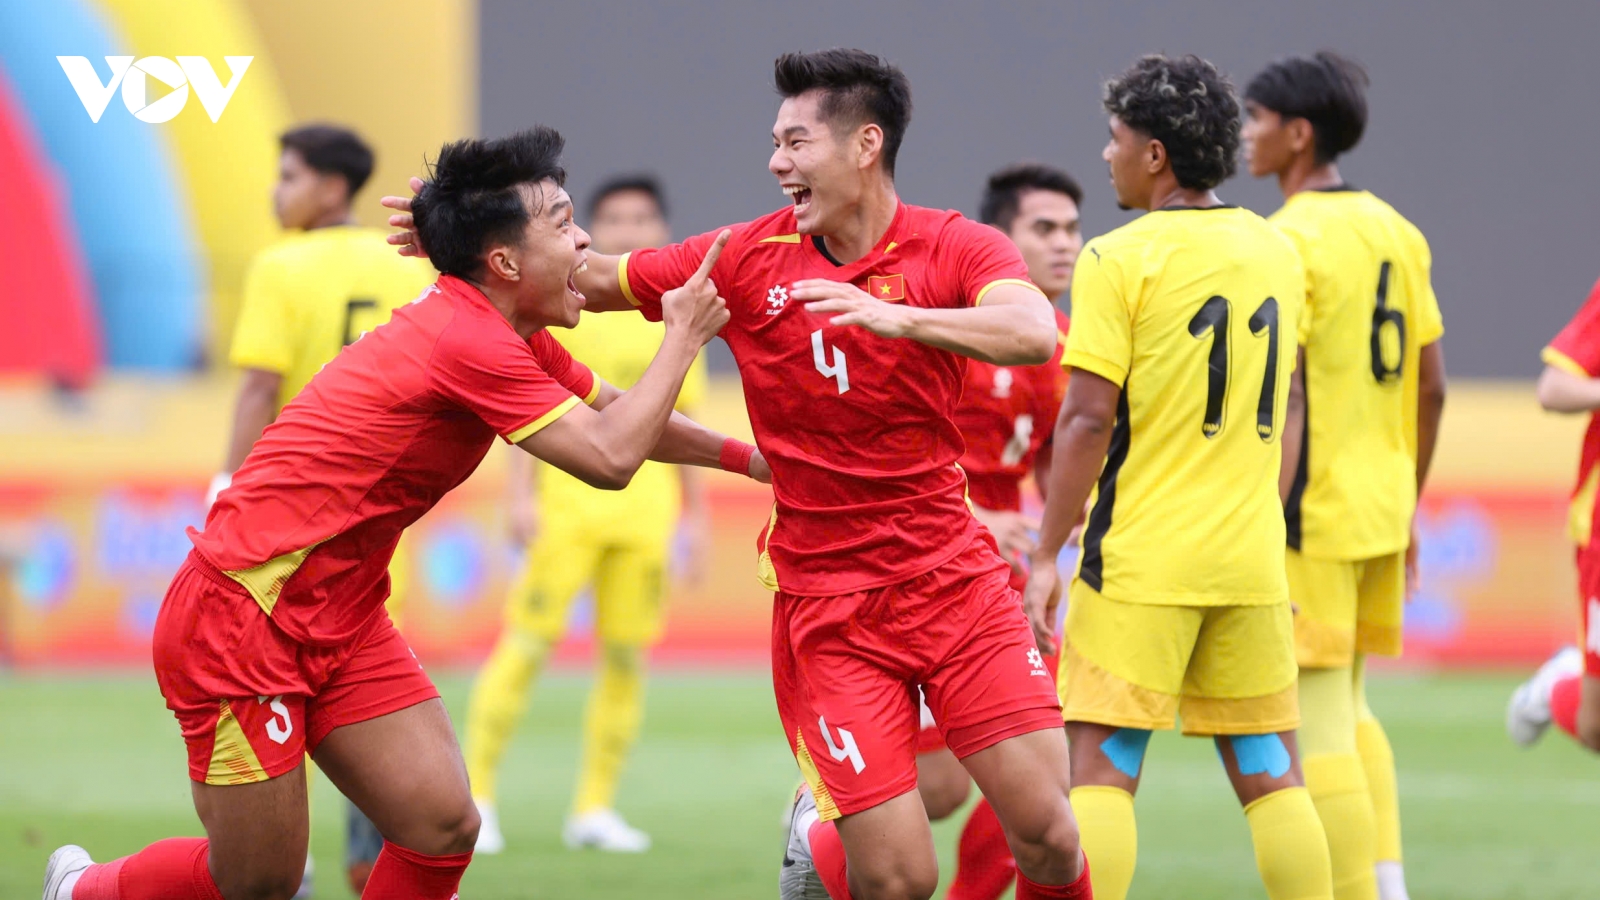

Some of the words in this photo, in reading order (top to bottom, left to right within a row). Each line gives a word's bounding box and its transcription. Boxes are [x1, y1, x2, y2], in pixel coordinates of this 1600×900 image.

[1371, 260, 1406, 386] 6
[811, 328, 850, 396] 4
[1187, 295, 1279, 443] 11
[258, 695, 293, 745] 3
[818, 715, 867, 776] 4
